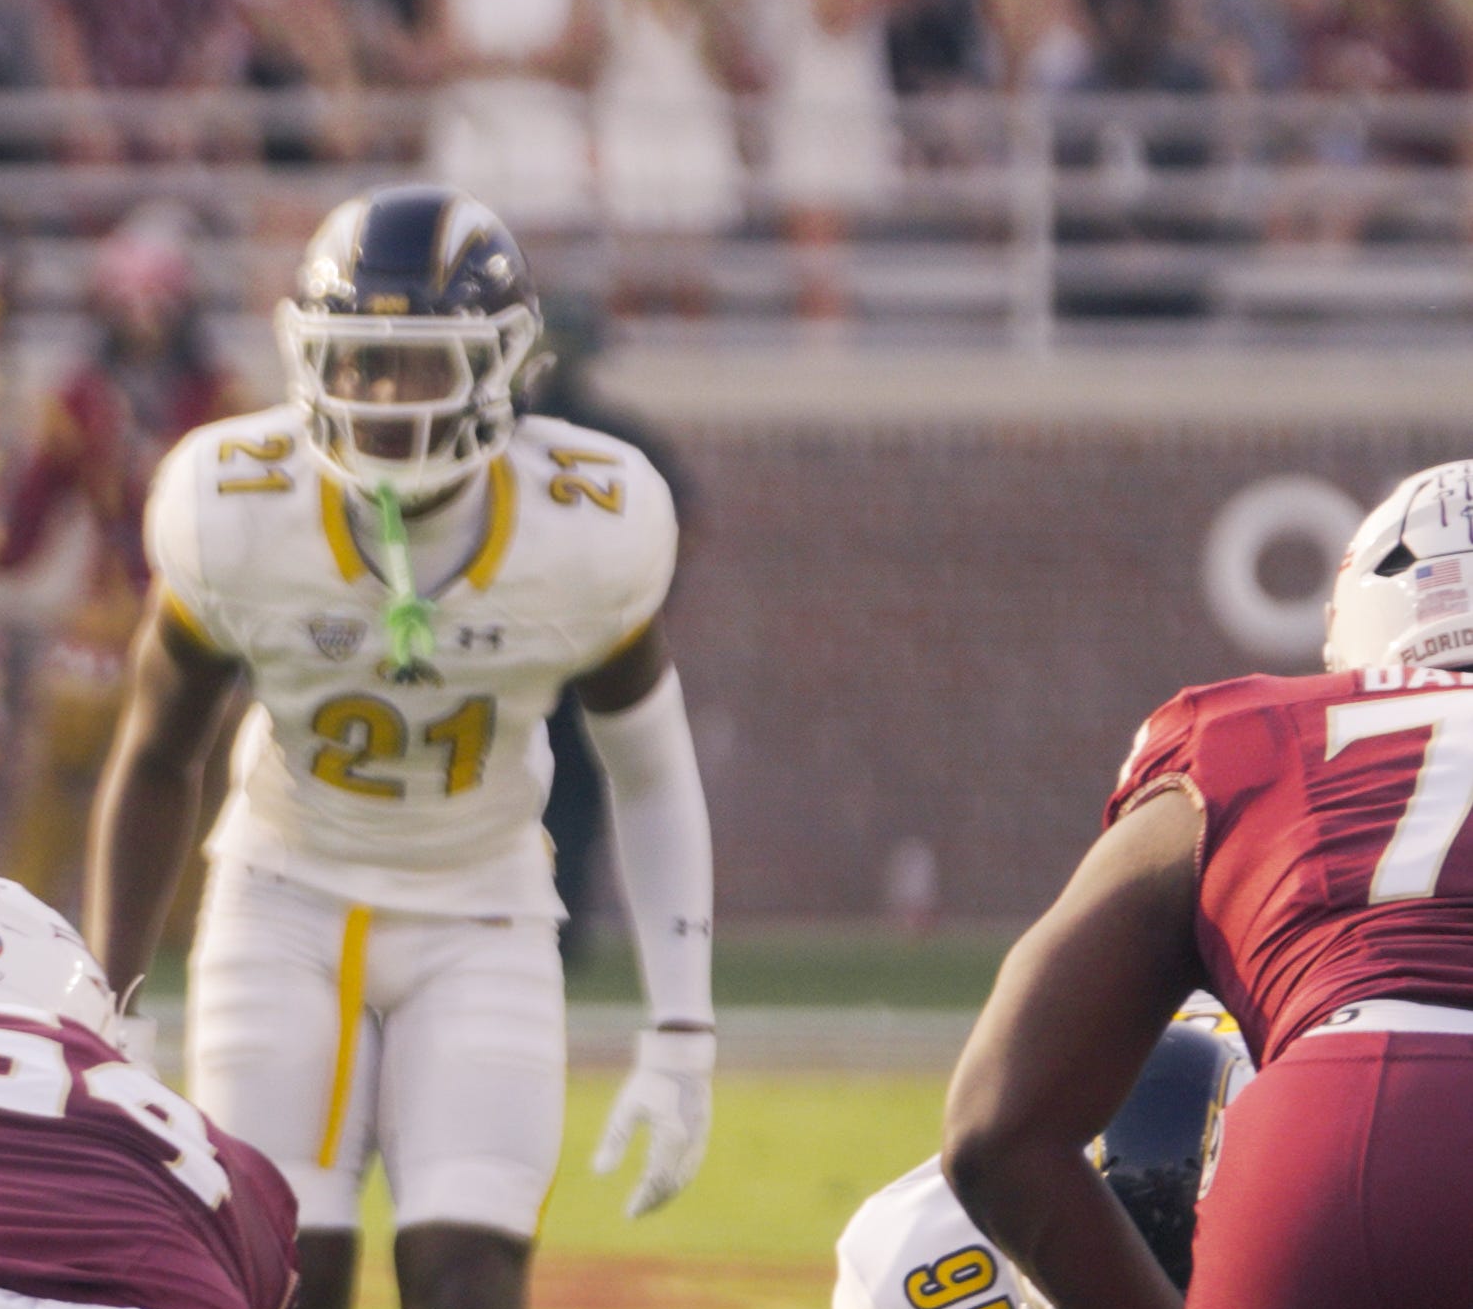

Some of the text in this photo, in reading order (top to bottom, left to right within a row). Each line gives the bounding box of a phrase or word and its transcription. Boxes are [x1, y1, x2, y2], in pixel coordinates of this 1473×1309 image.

[216, 433, 294, 497] 21
[548, 447, 627, 517] 21
[310, 691, 499, 801] 21
[1324, 690, 1473, 906] 7
